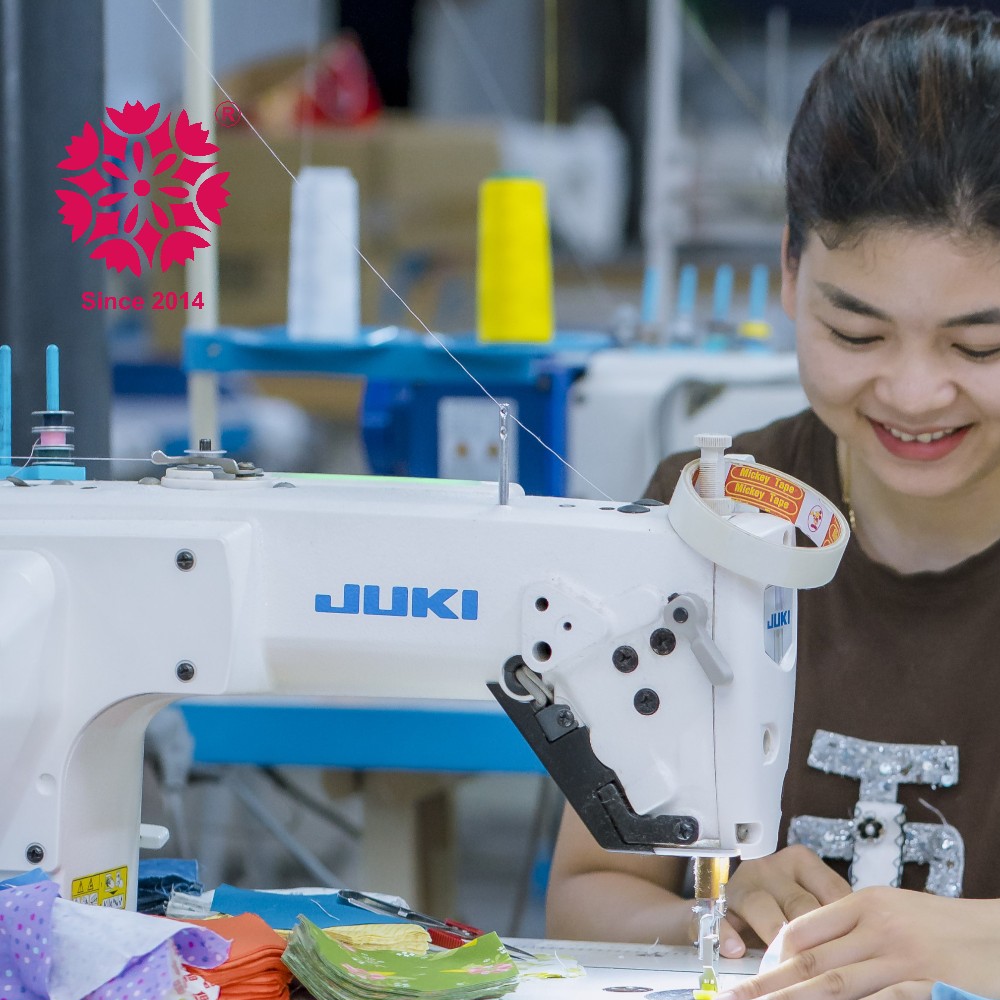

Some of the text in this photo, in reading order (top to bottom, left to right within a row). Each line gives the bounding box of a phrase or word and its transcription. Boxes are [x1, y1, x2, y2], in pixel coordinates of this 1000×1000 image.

[740, 467, 795, 493] Mickey Tape
[735, 482, 790, 509] Mickey Tape
[314, 583, 479, 621] JUKI
[767, 610, 790, 629] JUKI
